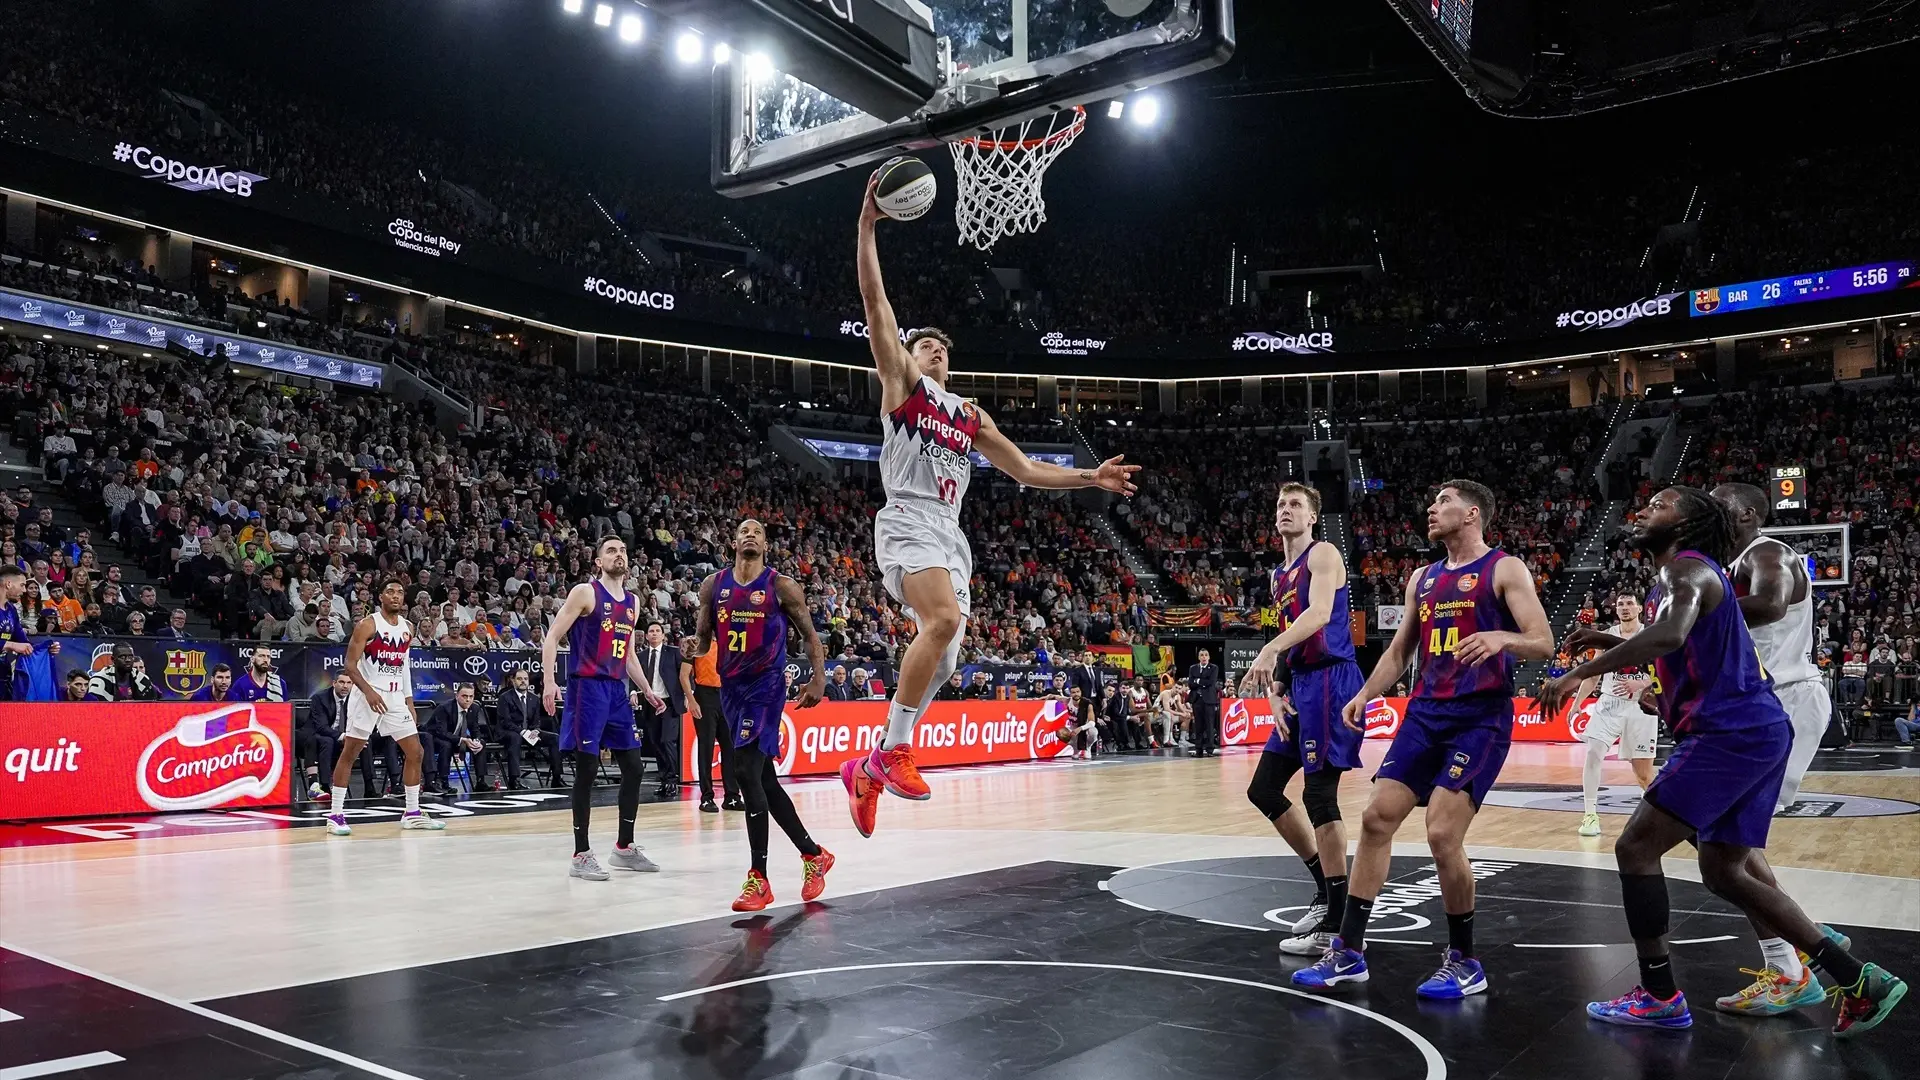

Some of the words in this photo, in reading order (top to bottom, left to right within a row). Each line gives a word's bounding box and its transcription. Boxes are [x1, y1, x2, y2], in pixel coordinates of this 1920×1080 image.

[112, 141, 252, 197] #CopaACB
[894, 196, 909, 204] Rey
[395, 217, 414, 229] acb
[388, 222, 422, 242] Copa
[423, 234, 438, 245] del
[439, 236, 461, 254] Rey
[394, 238, 423, 252] Valencia
[423, 246, 441, 257] 2026
[1793, 277, 1812, 287] FALTAS
[1852, 267, 1888, 288] 5:56
[583, 276, 675, 310] #CopaACB
[1728, 290, 1748, 303] BAR
[1762, 283, 1781, 300] 26
[1799, 287, 1808, 295] TM
[1555, 298, 1671, 327] #CopaACB
[1040, 336, 1071, 348] Copa
[1072, 339, 1085, 347] del
[1086, 338, 1106, 350] Rey
[1046, 331, 1063, 339] acb
[1231, 332, 1333, 352] #CopaACB
[1046, 347, 1073, 355] Valencia
[1776, 467, 1800, 477] 5:56
[937, 475, 957, 505] 10
[1780, 479, 1795, 496] 9
[731, 609, 765, 618] Assistència
[1434, 599, 1475, 611] Assistència
[1434, 609, 1462, 619] Sanitària
[611, 639, 626, 659] 13
[727, 630, 747, 652] 21
[1428, 626, 1459, 656] 44
[238, 647, 283, 659] Koer
[1230, 660, 1253, 669] SALID
[389, 681, 398, 692] 11
[801, 725, 849, 763] que
[919, 724, 954, 748] nos
[960, 713, 979, 746] lo
[981, 711, 1027, 752] quite
[4, 738, 81, 783] quit
[156, 744, 266, 784] Campofrío
